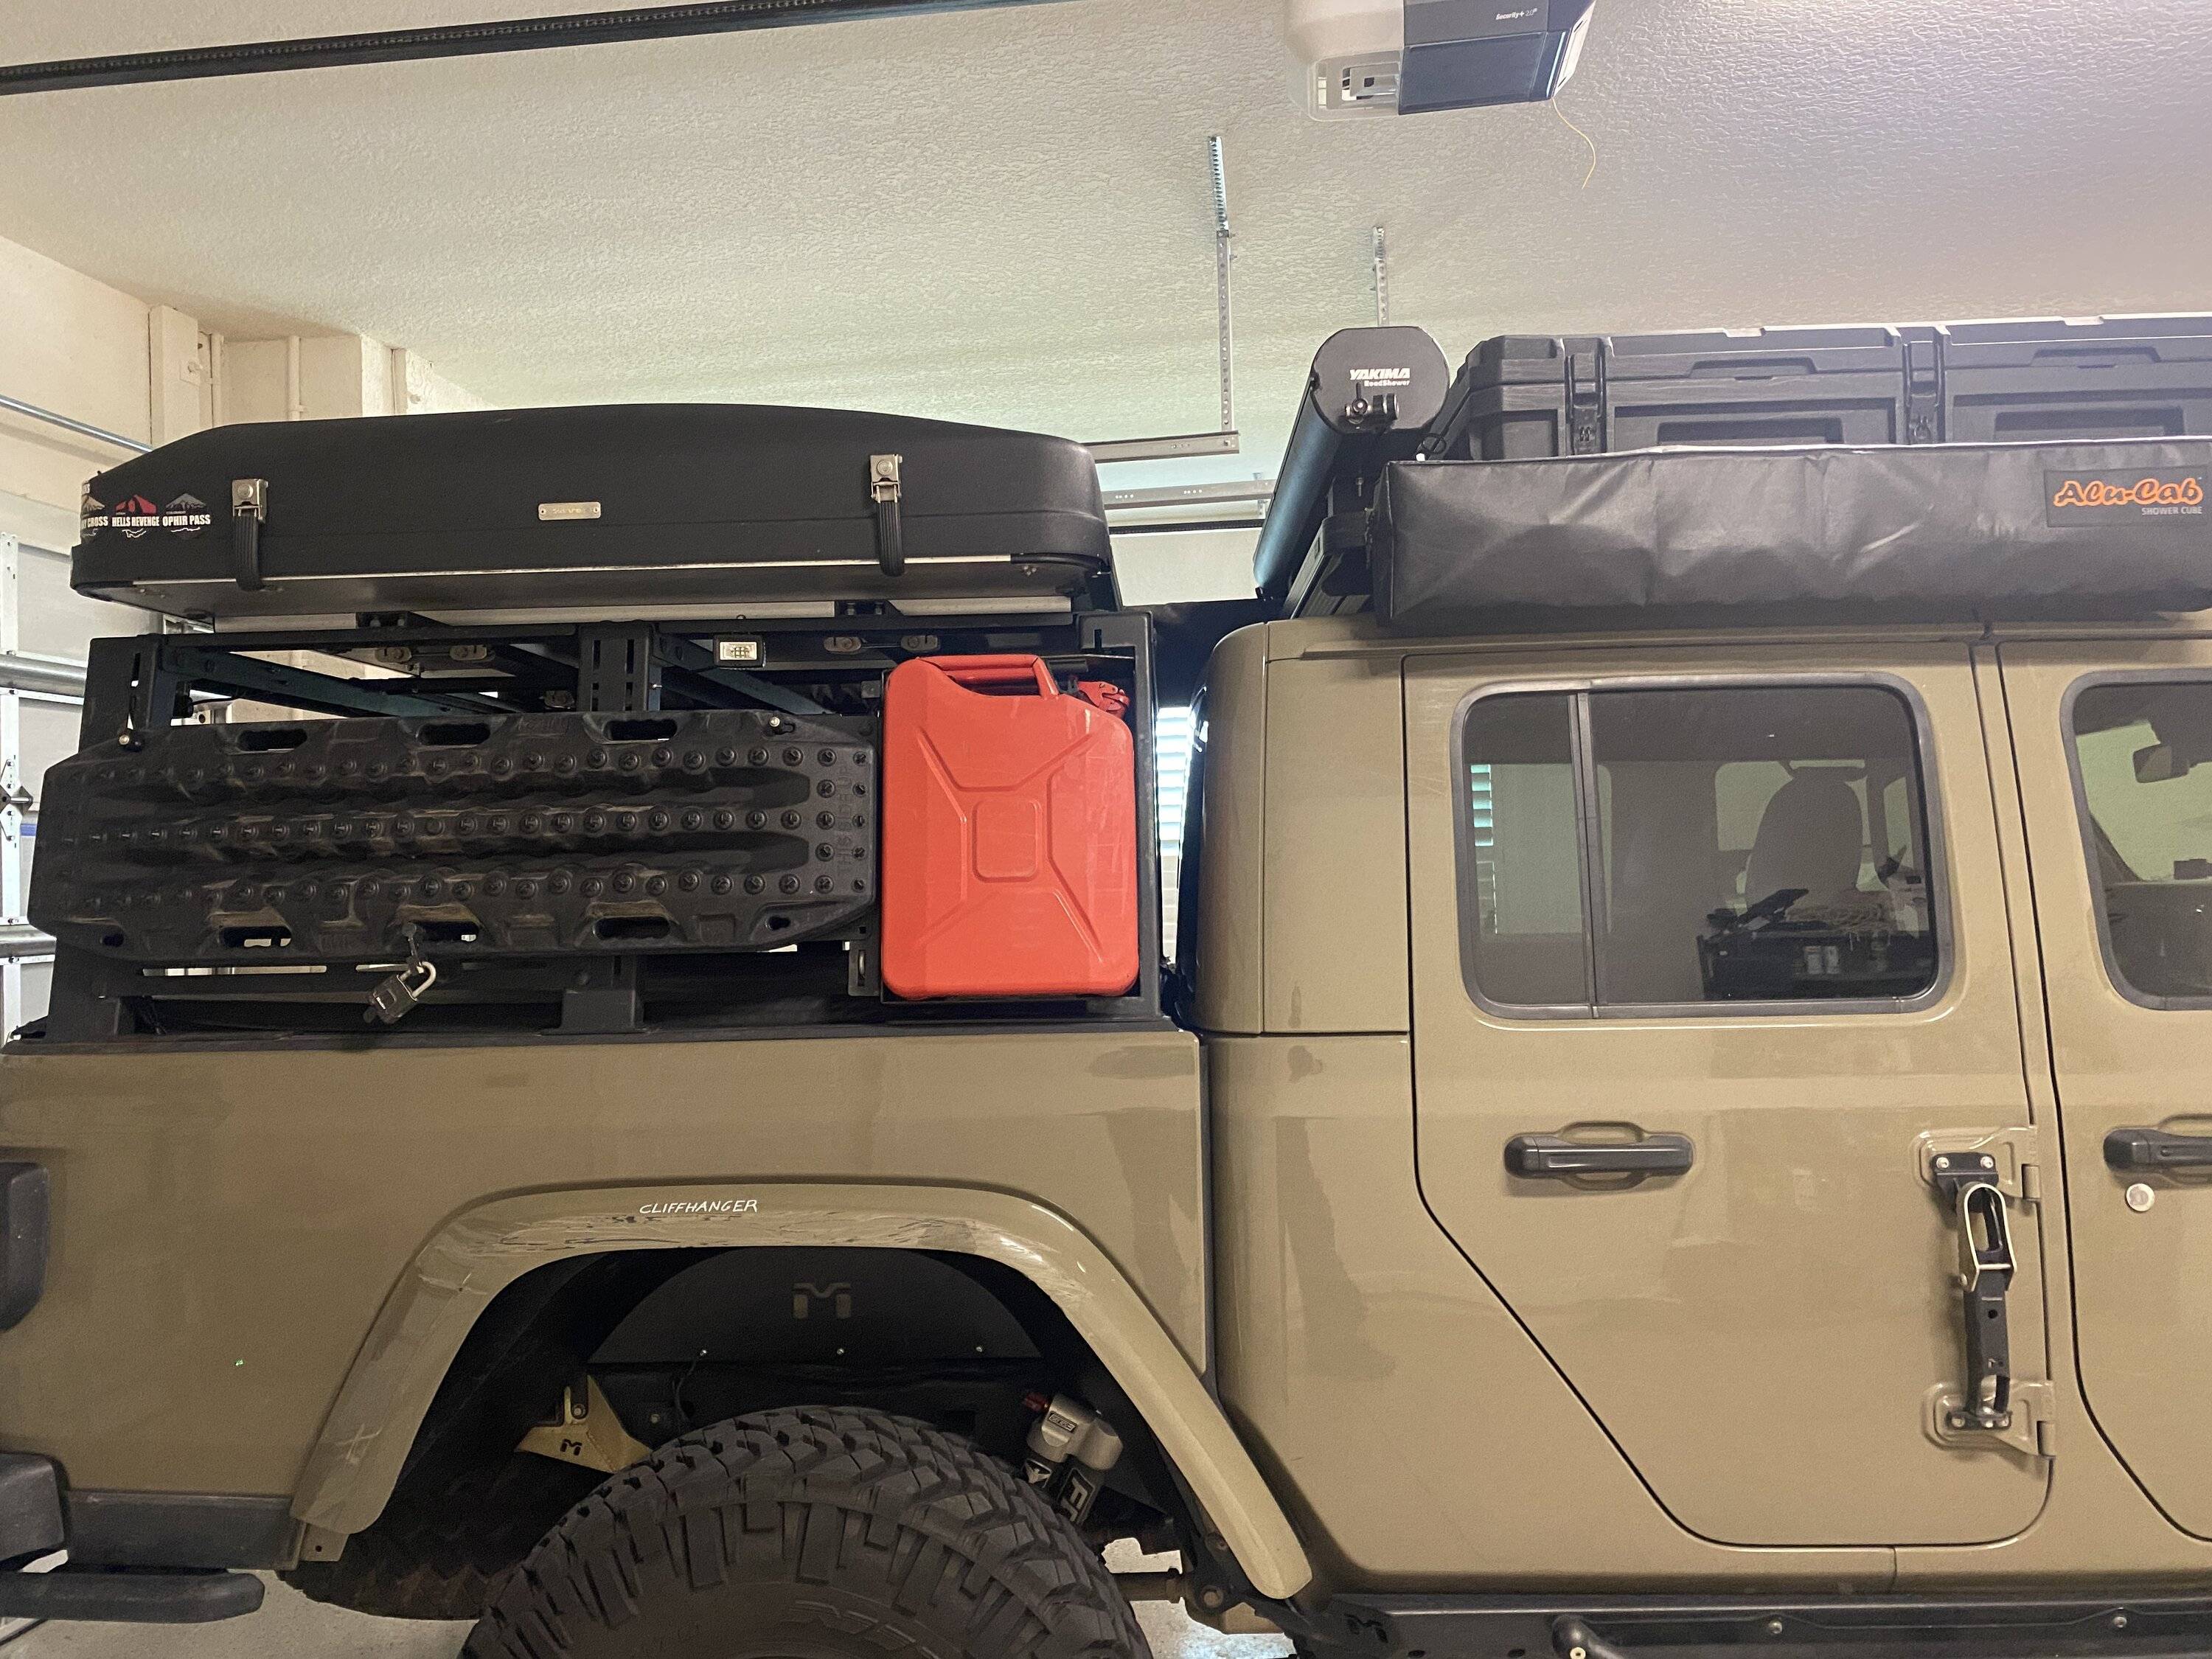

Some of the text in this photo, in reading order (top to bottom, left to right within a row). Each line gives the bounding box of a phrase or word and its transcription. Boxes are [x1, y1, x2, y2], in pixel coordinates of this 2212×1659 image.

[1349, 368, 1411, 380] YAKIMA
[2053, 478, 2203, 507] Alu-Cab
[2141, 507, 2203, 515] SHOWER CUBE
[87, 516, 108, 527] CROSS
[112, 516, 160, 526] HELLS REVENGE
[162, 514, 211, 526] OPHIR PASS
[639, 1200, 757, 1214] CLIFFHANGER
